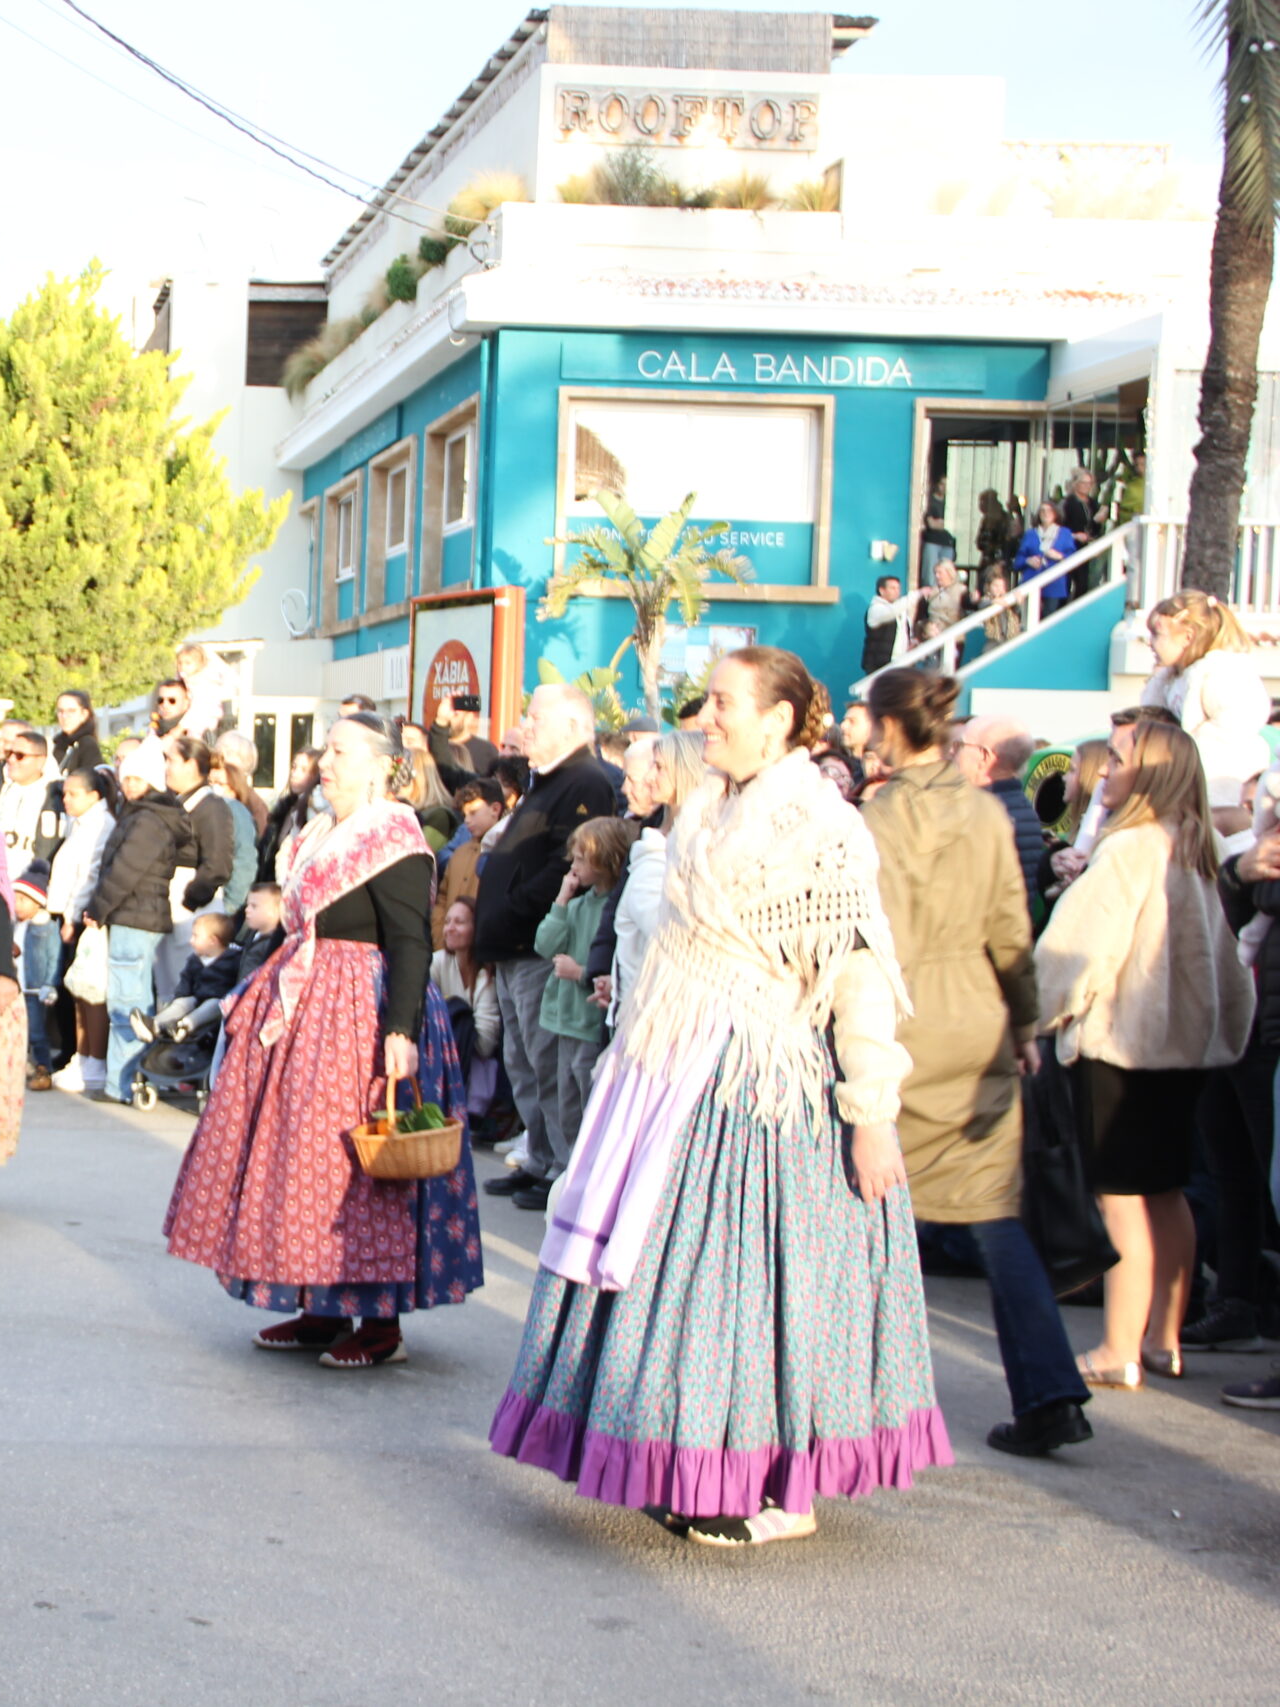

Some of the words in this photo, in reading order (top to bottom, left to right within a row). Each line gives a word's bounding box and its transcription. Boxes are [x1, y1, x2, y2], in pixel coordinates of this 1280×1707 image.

[559, 88, 818, 142] ROOFTOP
[637, 350, 738, 382] CALA
[753, 353, 913, 387] BANDIDA
[719, 531, 785, 547] SERVICE
[433, 655, 470, 685] XÀBIA
